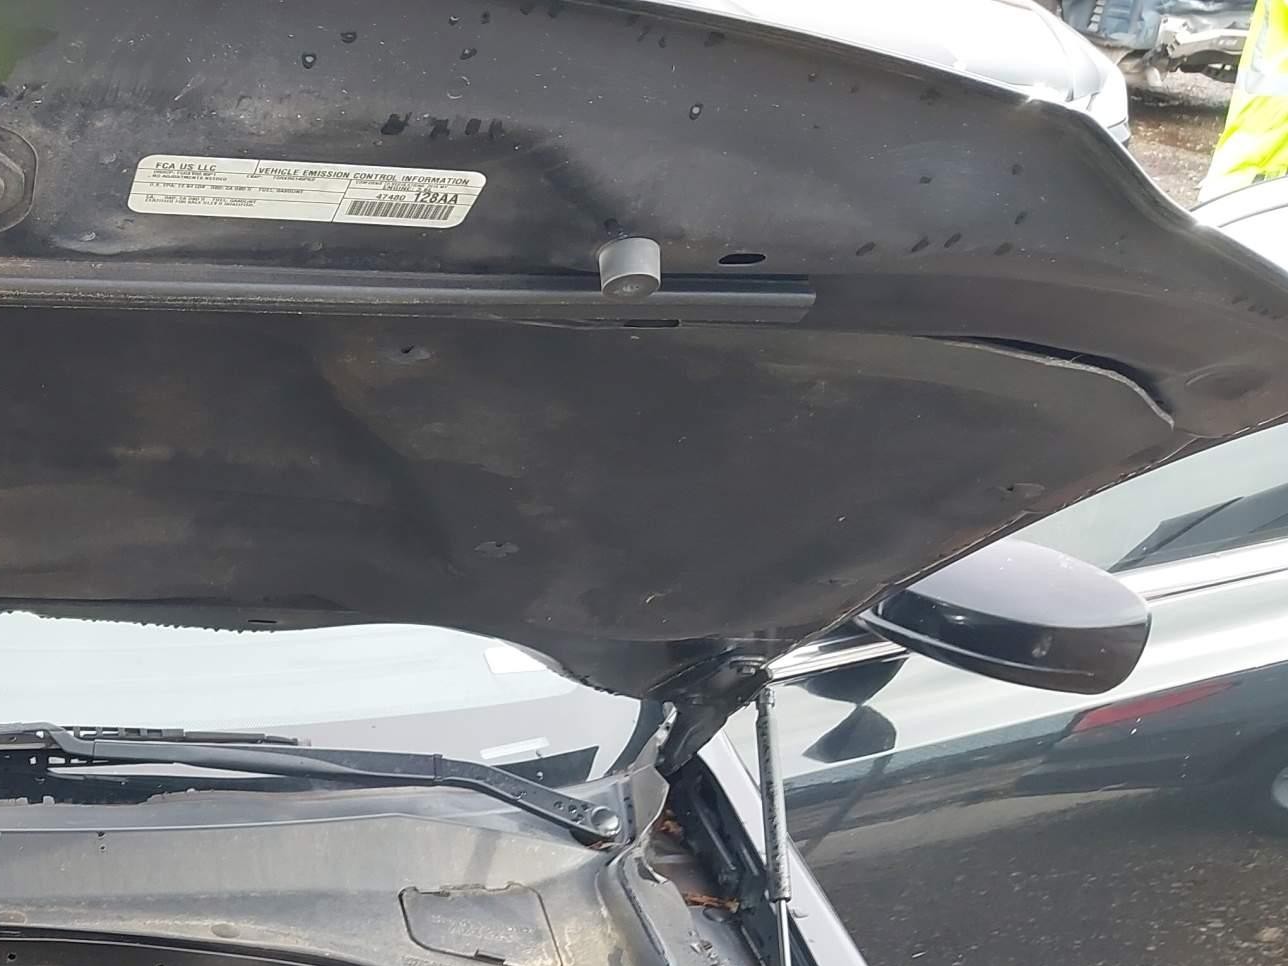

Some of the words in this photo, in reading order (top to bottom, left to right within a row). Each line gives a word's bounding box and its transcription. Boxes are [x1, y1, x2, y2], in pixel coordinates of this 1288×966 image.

[155, 161, 175, 170] FCA
[259, 167, 300, 175] VEHICLE
[302, 169, 350, 178] EMISSION
[353, 172, 397, 181] CONTROL
[401, 175, 470, 185] INFORMATION
[414, 192, 458, 204] 128AA
